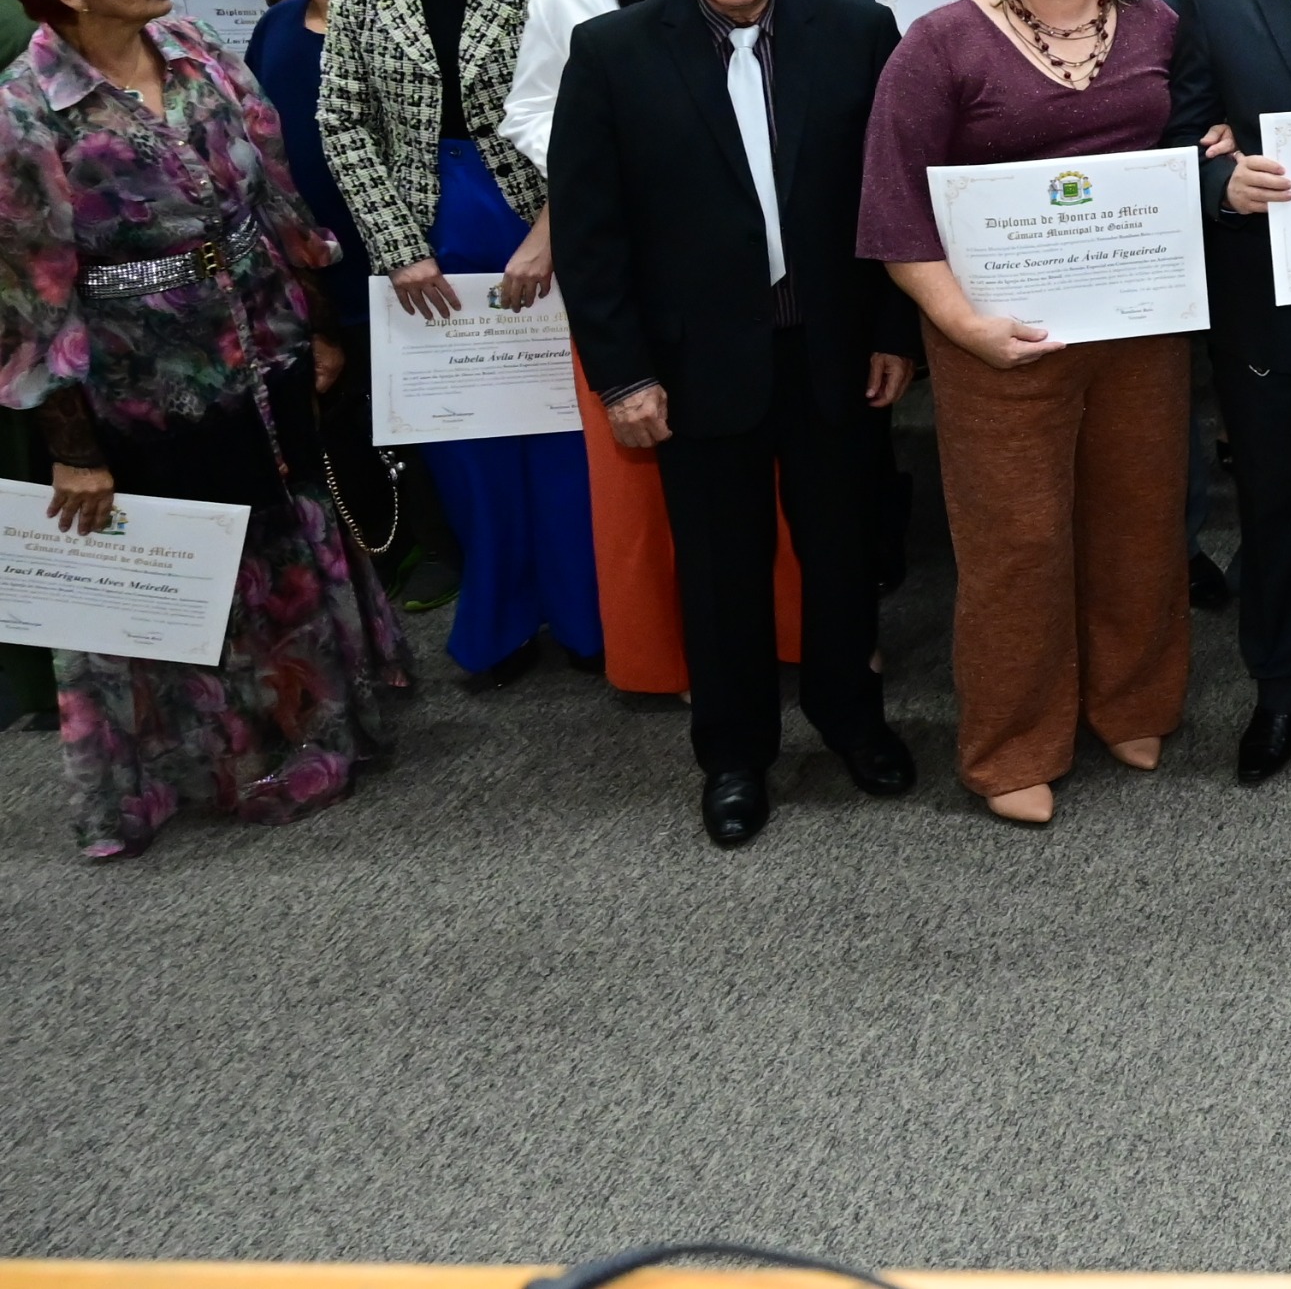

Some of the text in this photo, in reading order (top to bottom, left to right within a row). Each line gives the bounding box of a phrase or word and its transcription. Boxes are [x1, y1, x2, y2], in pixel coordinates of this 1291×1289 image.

[214, 8, 257, 16] Diploma
[984, 204, 1158, 229] Diploma de Honra ao Mérito
[1006, 230, 1043, 240] Câmara
[1046, 225, 1092, 238] Municipal
[1106, 220, 1142, 231] Goiânia
[983, 244, 1167, 270] Clarice Socorro de Ávila Figueiredo
[423, 314, 549, 328] Diploma de ao
[444, 326, 539, 338] Câmara Municipal de
[448, 348, 572, 364] Isabela Ávila Figueiredo
[2, 525, 194, 559] Diploma de ao Mérito
[24, 542, 173, 568] Câmara Municipal de Goiânia
[3, 565, 178, 593] Iraci Rodrigues Alves Meirelles
